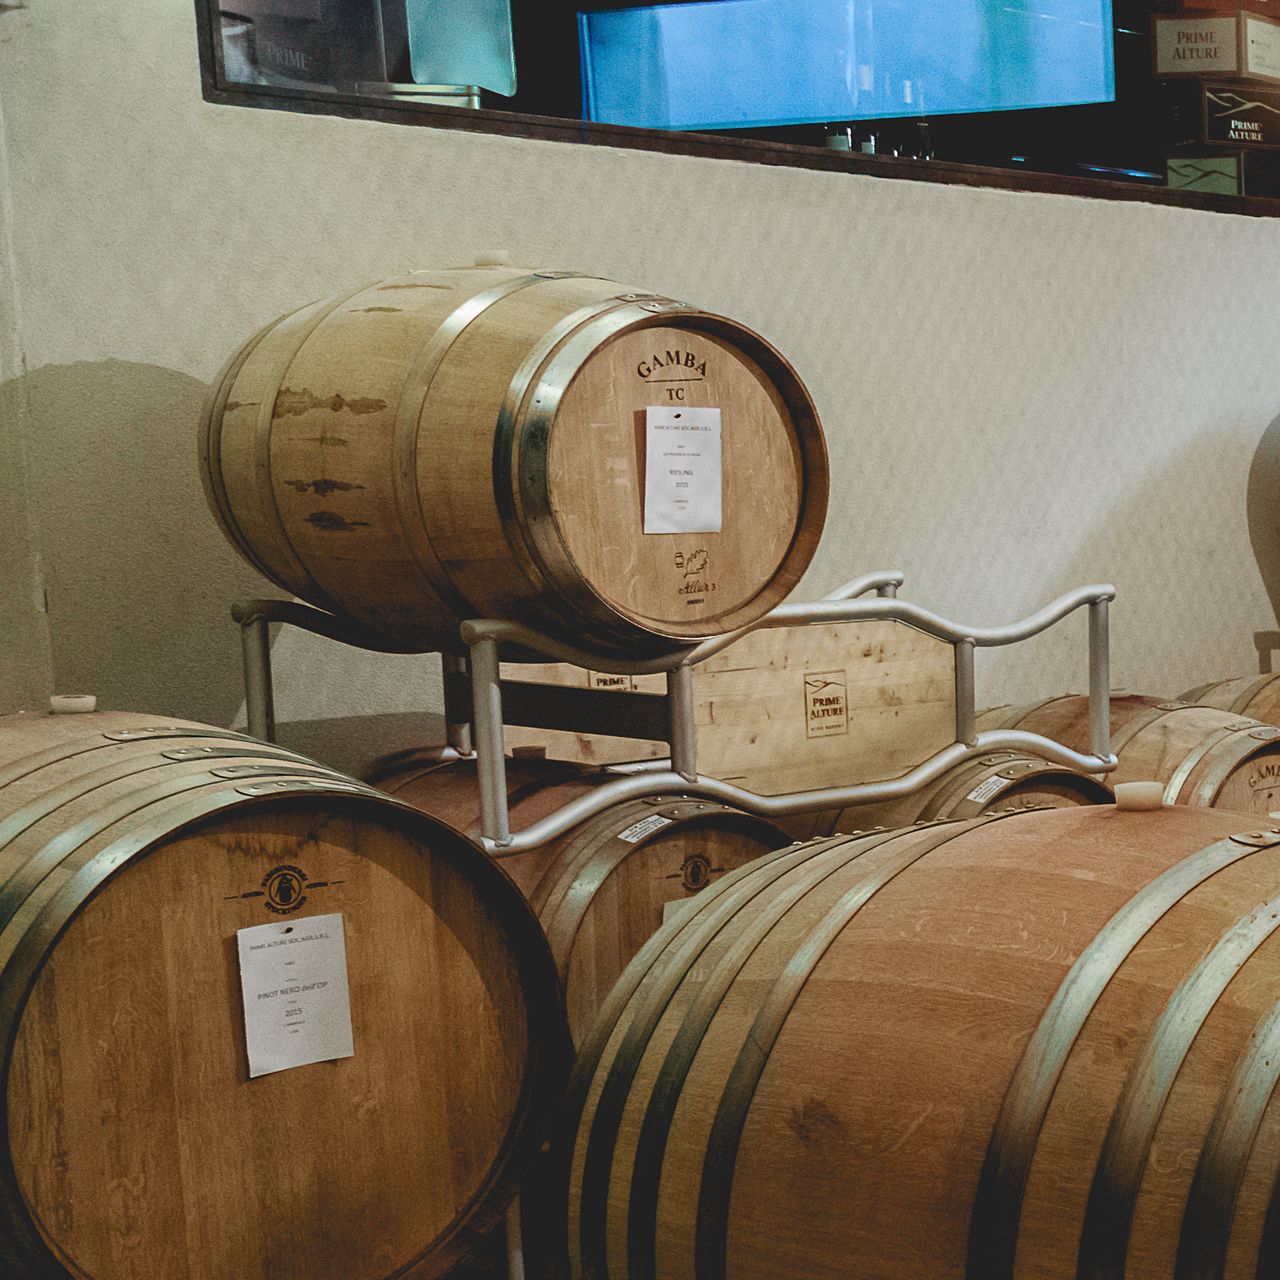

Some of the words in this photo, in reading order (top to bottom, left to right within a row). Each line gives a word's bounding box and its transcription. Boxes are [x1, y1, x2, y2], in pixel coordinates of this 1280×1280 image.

[1177, 31, 1217, 44] PRIME
[1172, 47, 1221, 60] ALTURE
[1231, 119, 1261, 131] PRIME
[1228, 129, 1264, 141] ALTURE
[637, 350, 706, 378] GAMBA
[666, 388, 685, 400] TC
[596, 677, 626, 687] PRIME
[812, 696, 842, 707] PRIME
[810, 707, 844, 720] ALTURE
